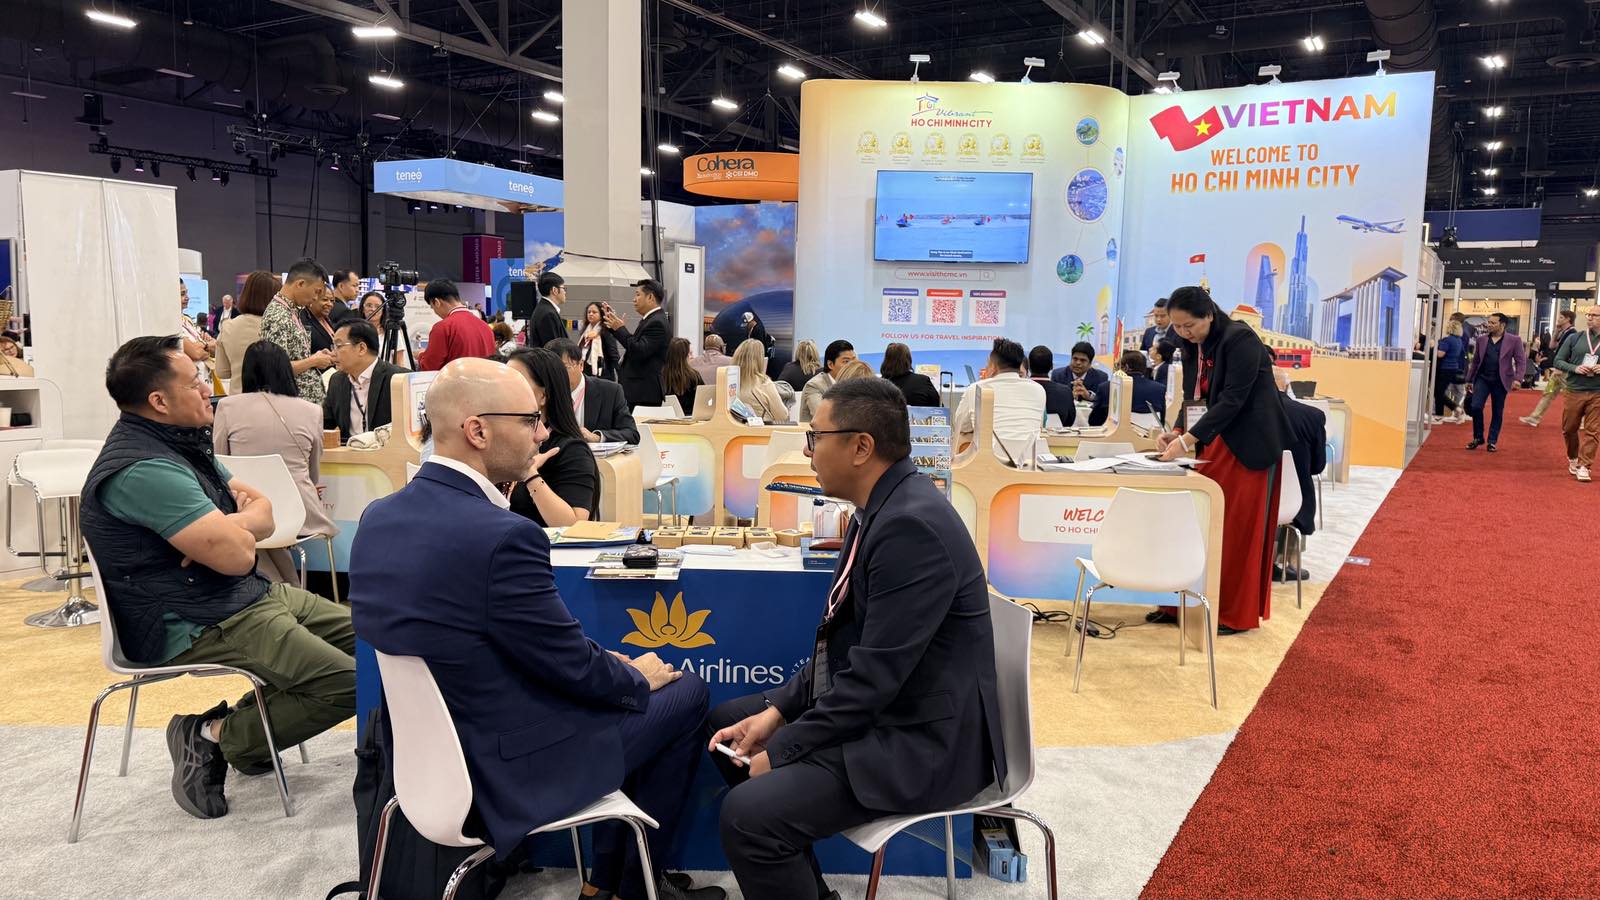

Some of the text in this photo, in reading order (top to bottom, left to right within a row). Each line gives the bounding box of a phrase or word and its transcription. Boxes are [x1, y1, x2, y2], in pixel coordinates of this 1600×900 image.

[1221, 92, 1397, 129] VIETNAM
[911, 118, 993, 128] HO CHI MINH CITY
[697, 154, 755, 171] Cohera
[1211, 143, 1319, 166] WELCOME TO
[1171, 164, 1360, 193] HO CHI MINH CITY
[1063, 507, 1105, 522] WELC
[1054, 525, 1066, 533] TO
[1068, 526, 1082, 534] HO
[680, 658, 784, 685] Airlines
